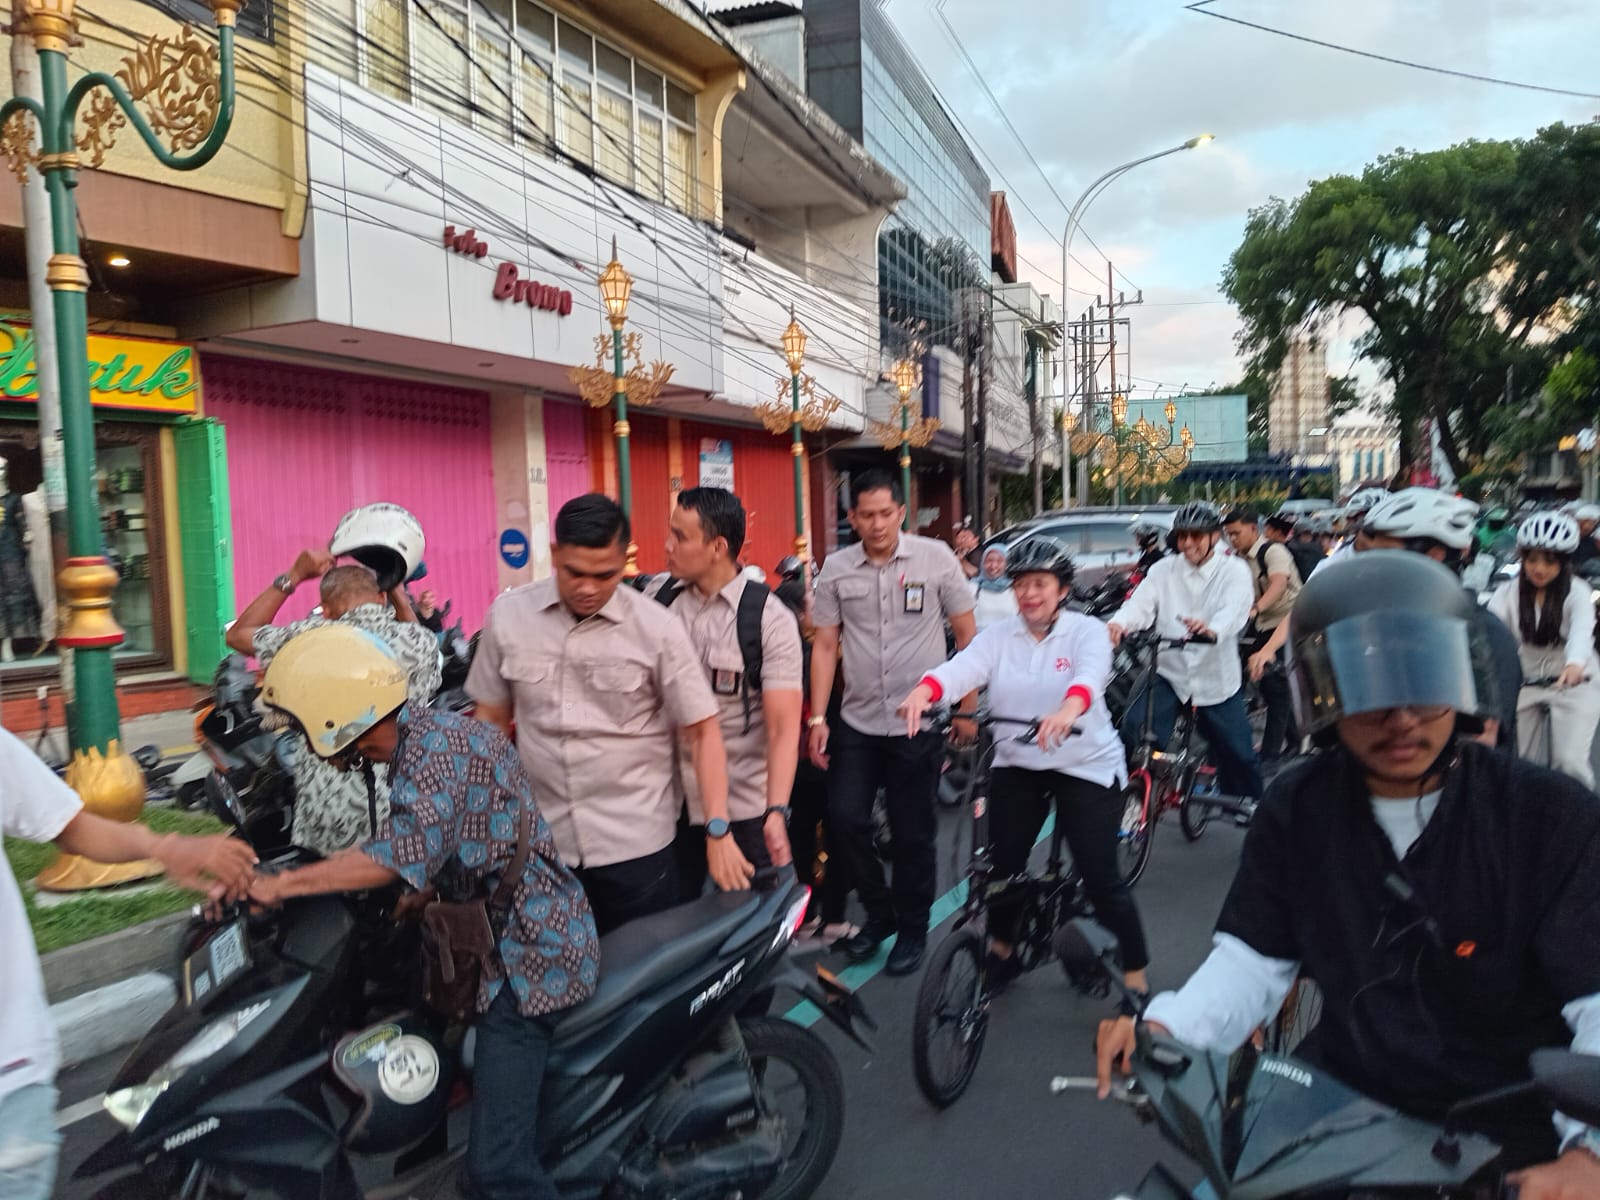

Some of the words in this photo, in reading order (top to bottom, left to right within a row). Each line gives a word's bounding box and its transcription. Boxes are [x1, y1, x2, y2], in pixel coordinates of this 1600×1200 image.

[493, 262, 572, 316] Bromo
[1261, 1060, 1312, 1088] HONDA
[163, 1116, 220, 1152] HONDA
